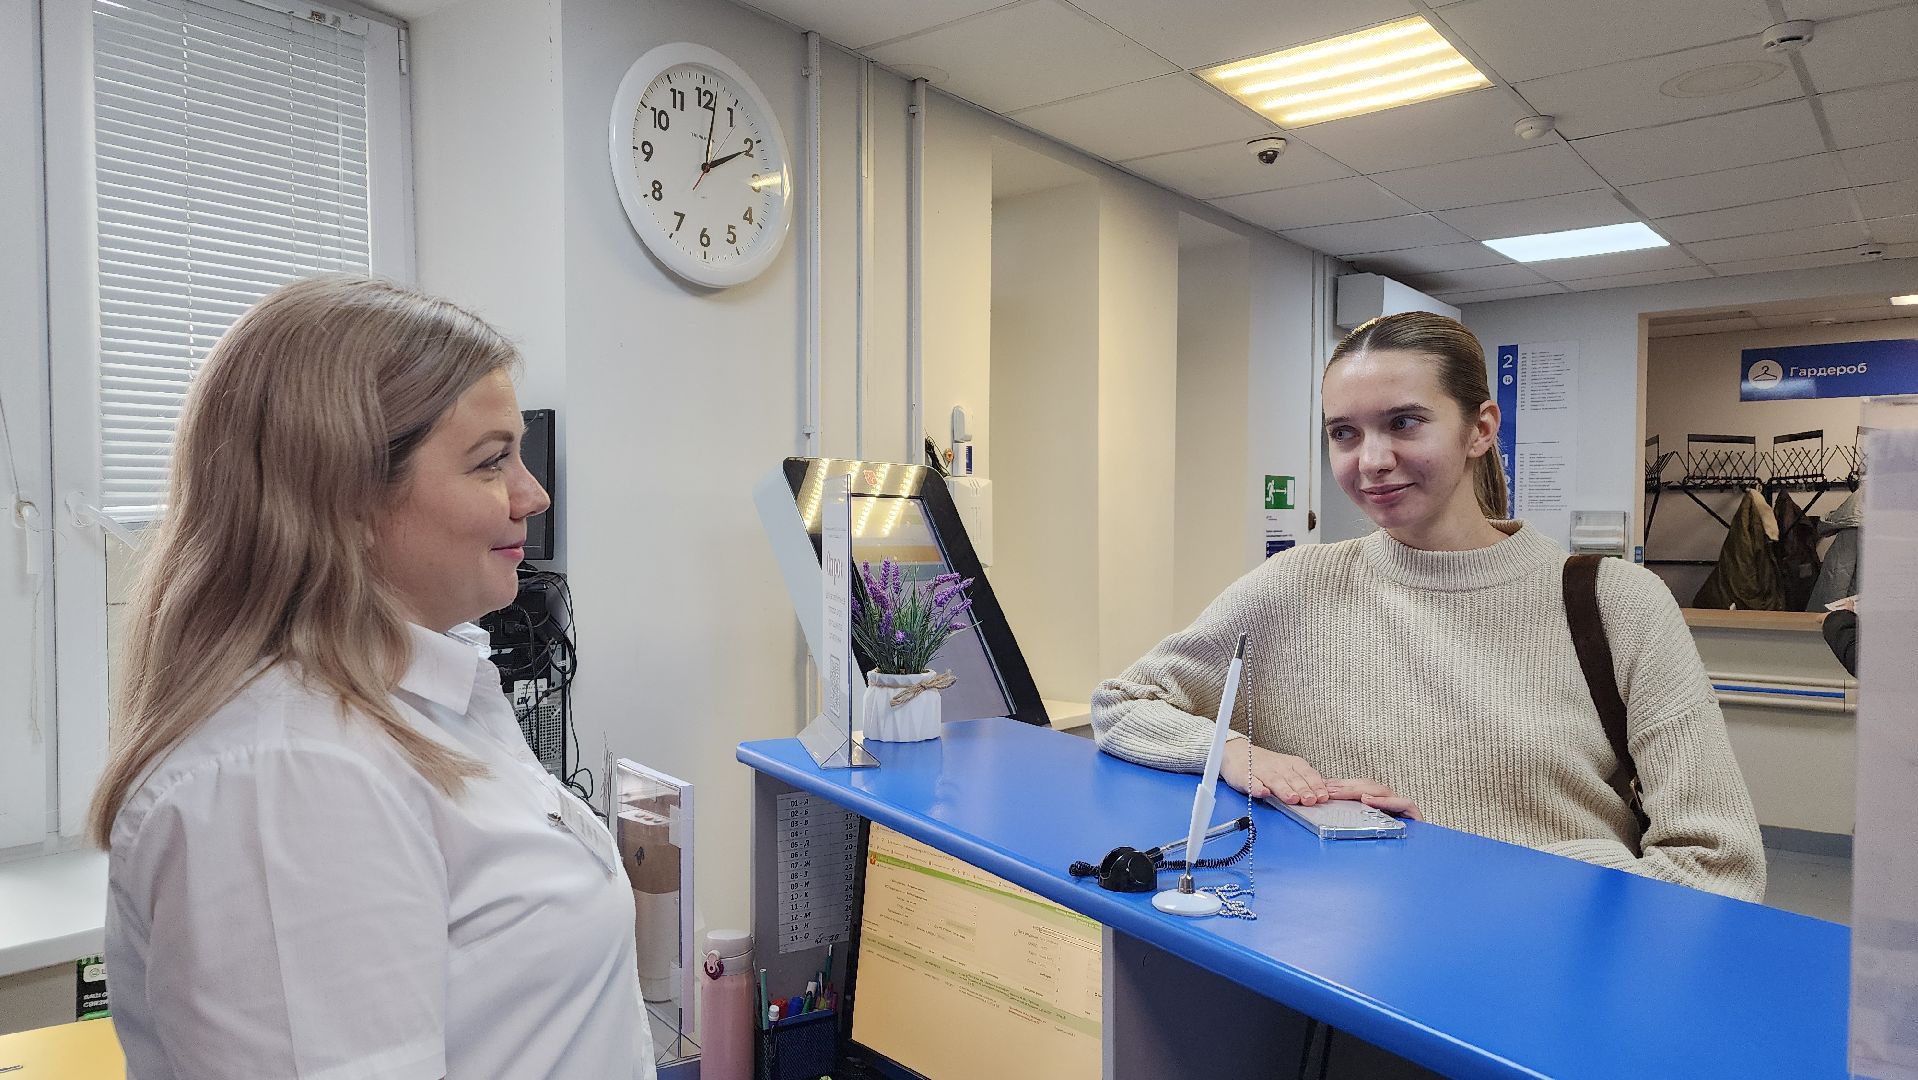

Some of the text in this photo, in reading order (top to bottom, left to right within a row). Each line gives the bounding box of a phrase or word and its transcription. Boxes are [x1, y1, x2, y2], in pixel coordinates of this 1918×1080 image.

[670, 87, 685, 111] 11
[695, 86, 715, 111] 12
[650, 106, 670, 131] 10
[727, 107, 734, 127] 1
[641, 140, 653, 162] 9
[743, 137, 754, 158] 2
[651, 180, 663, 201] 8
[673, 211, 686, 231] 7
[742, 206, 754, 225] 4
[700, 227, 711, 248] 6
[726, 224, 737, 245] 5
[1502, 354, 1513, 369] 2
[1789, 362, 1868, 378] Гардероб
